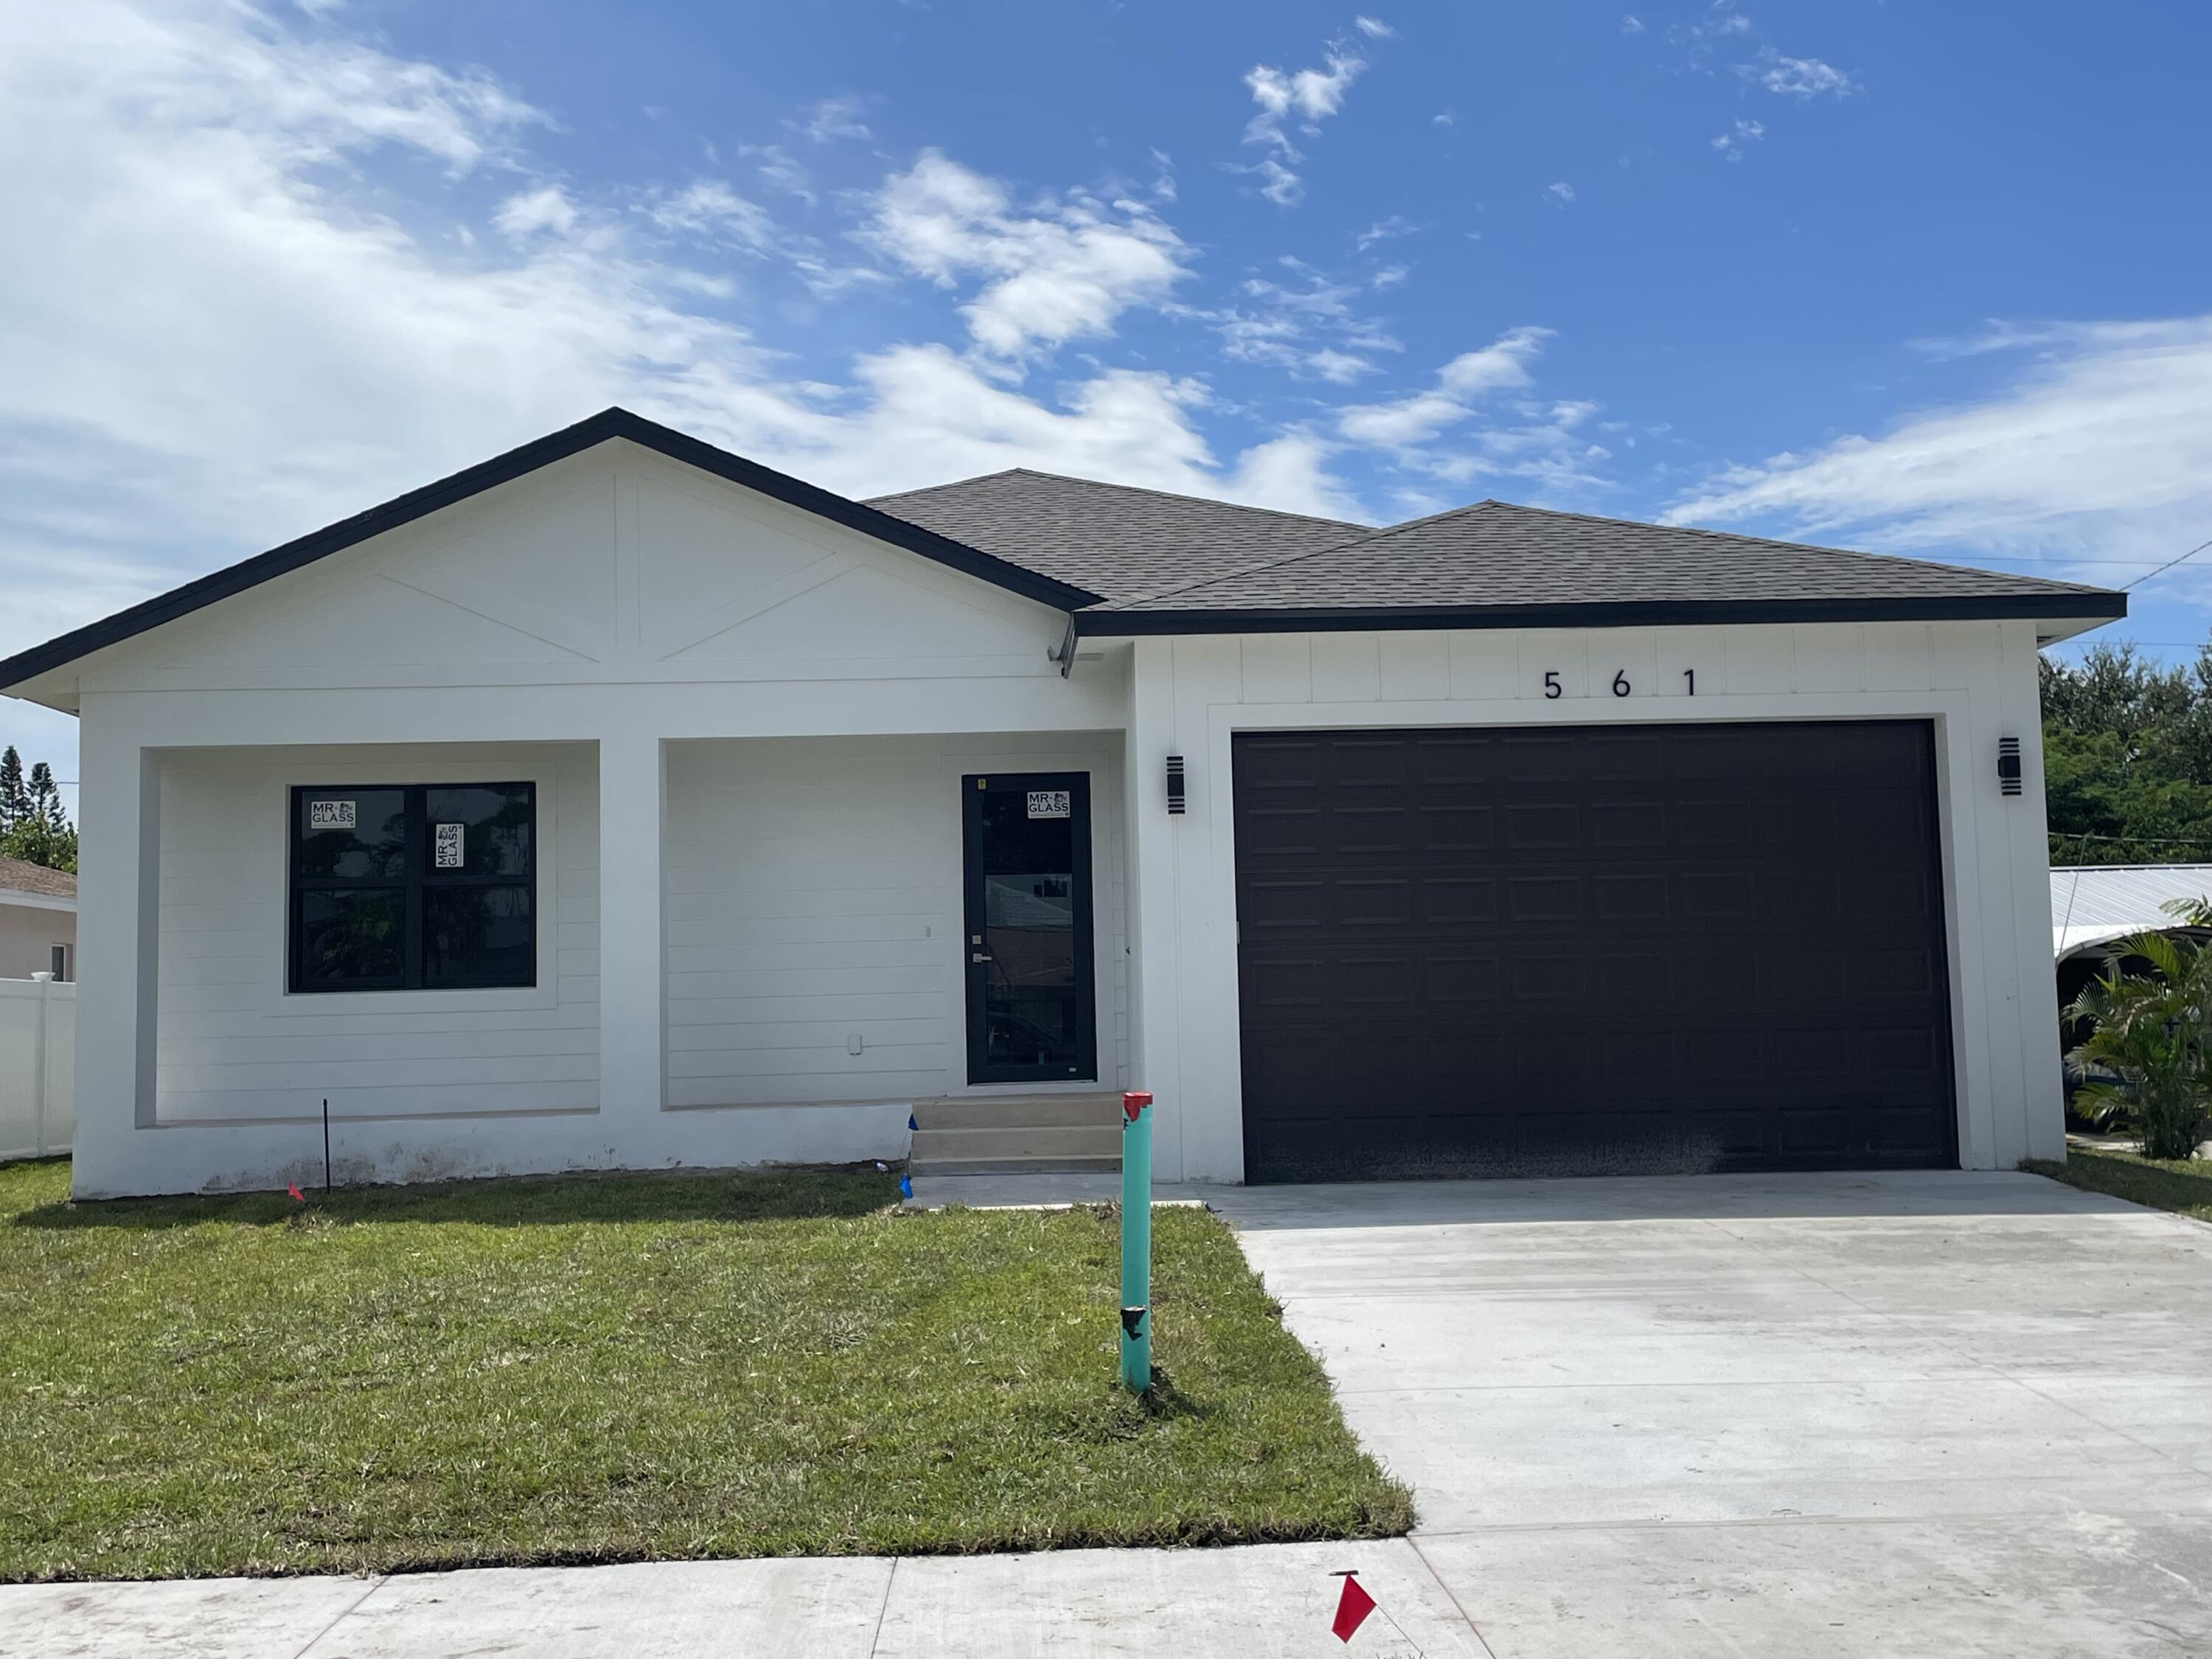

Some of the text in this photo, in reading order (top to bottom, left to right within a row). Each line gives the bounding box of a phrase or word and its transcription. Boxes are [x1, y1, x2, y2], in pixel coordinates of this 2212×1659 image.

[1029, 803, 1068, 812] GLASS
[313, 813, 354, 822] GLASS
[448, 825, 457, 866] GLASS
